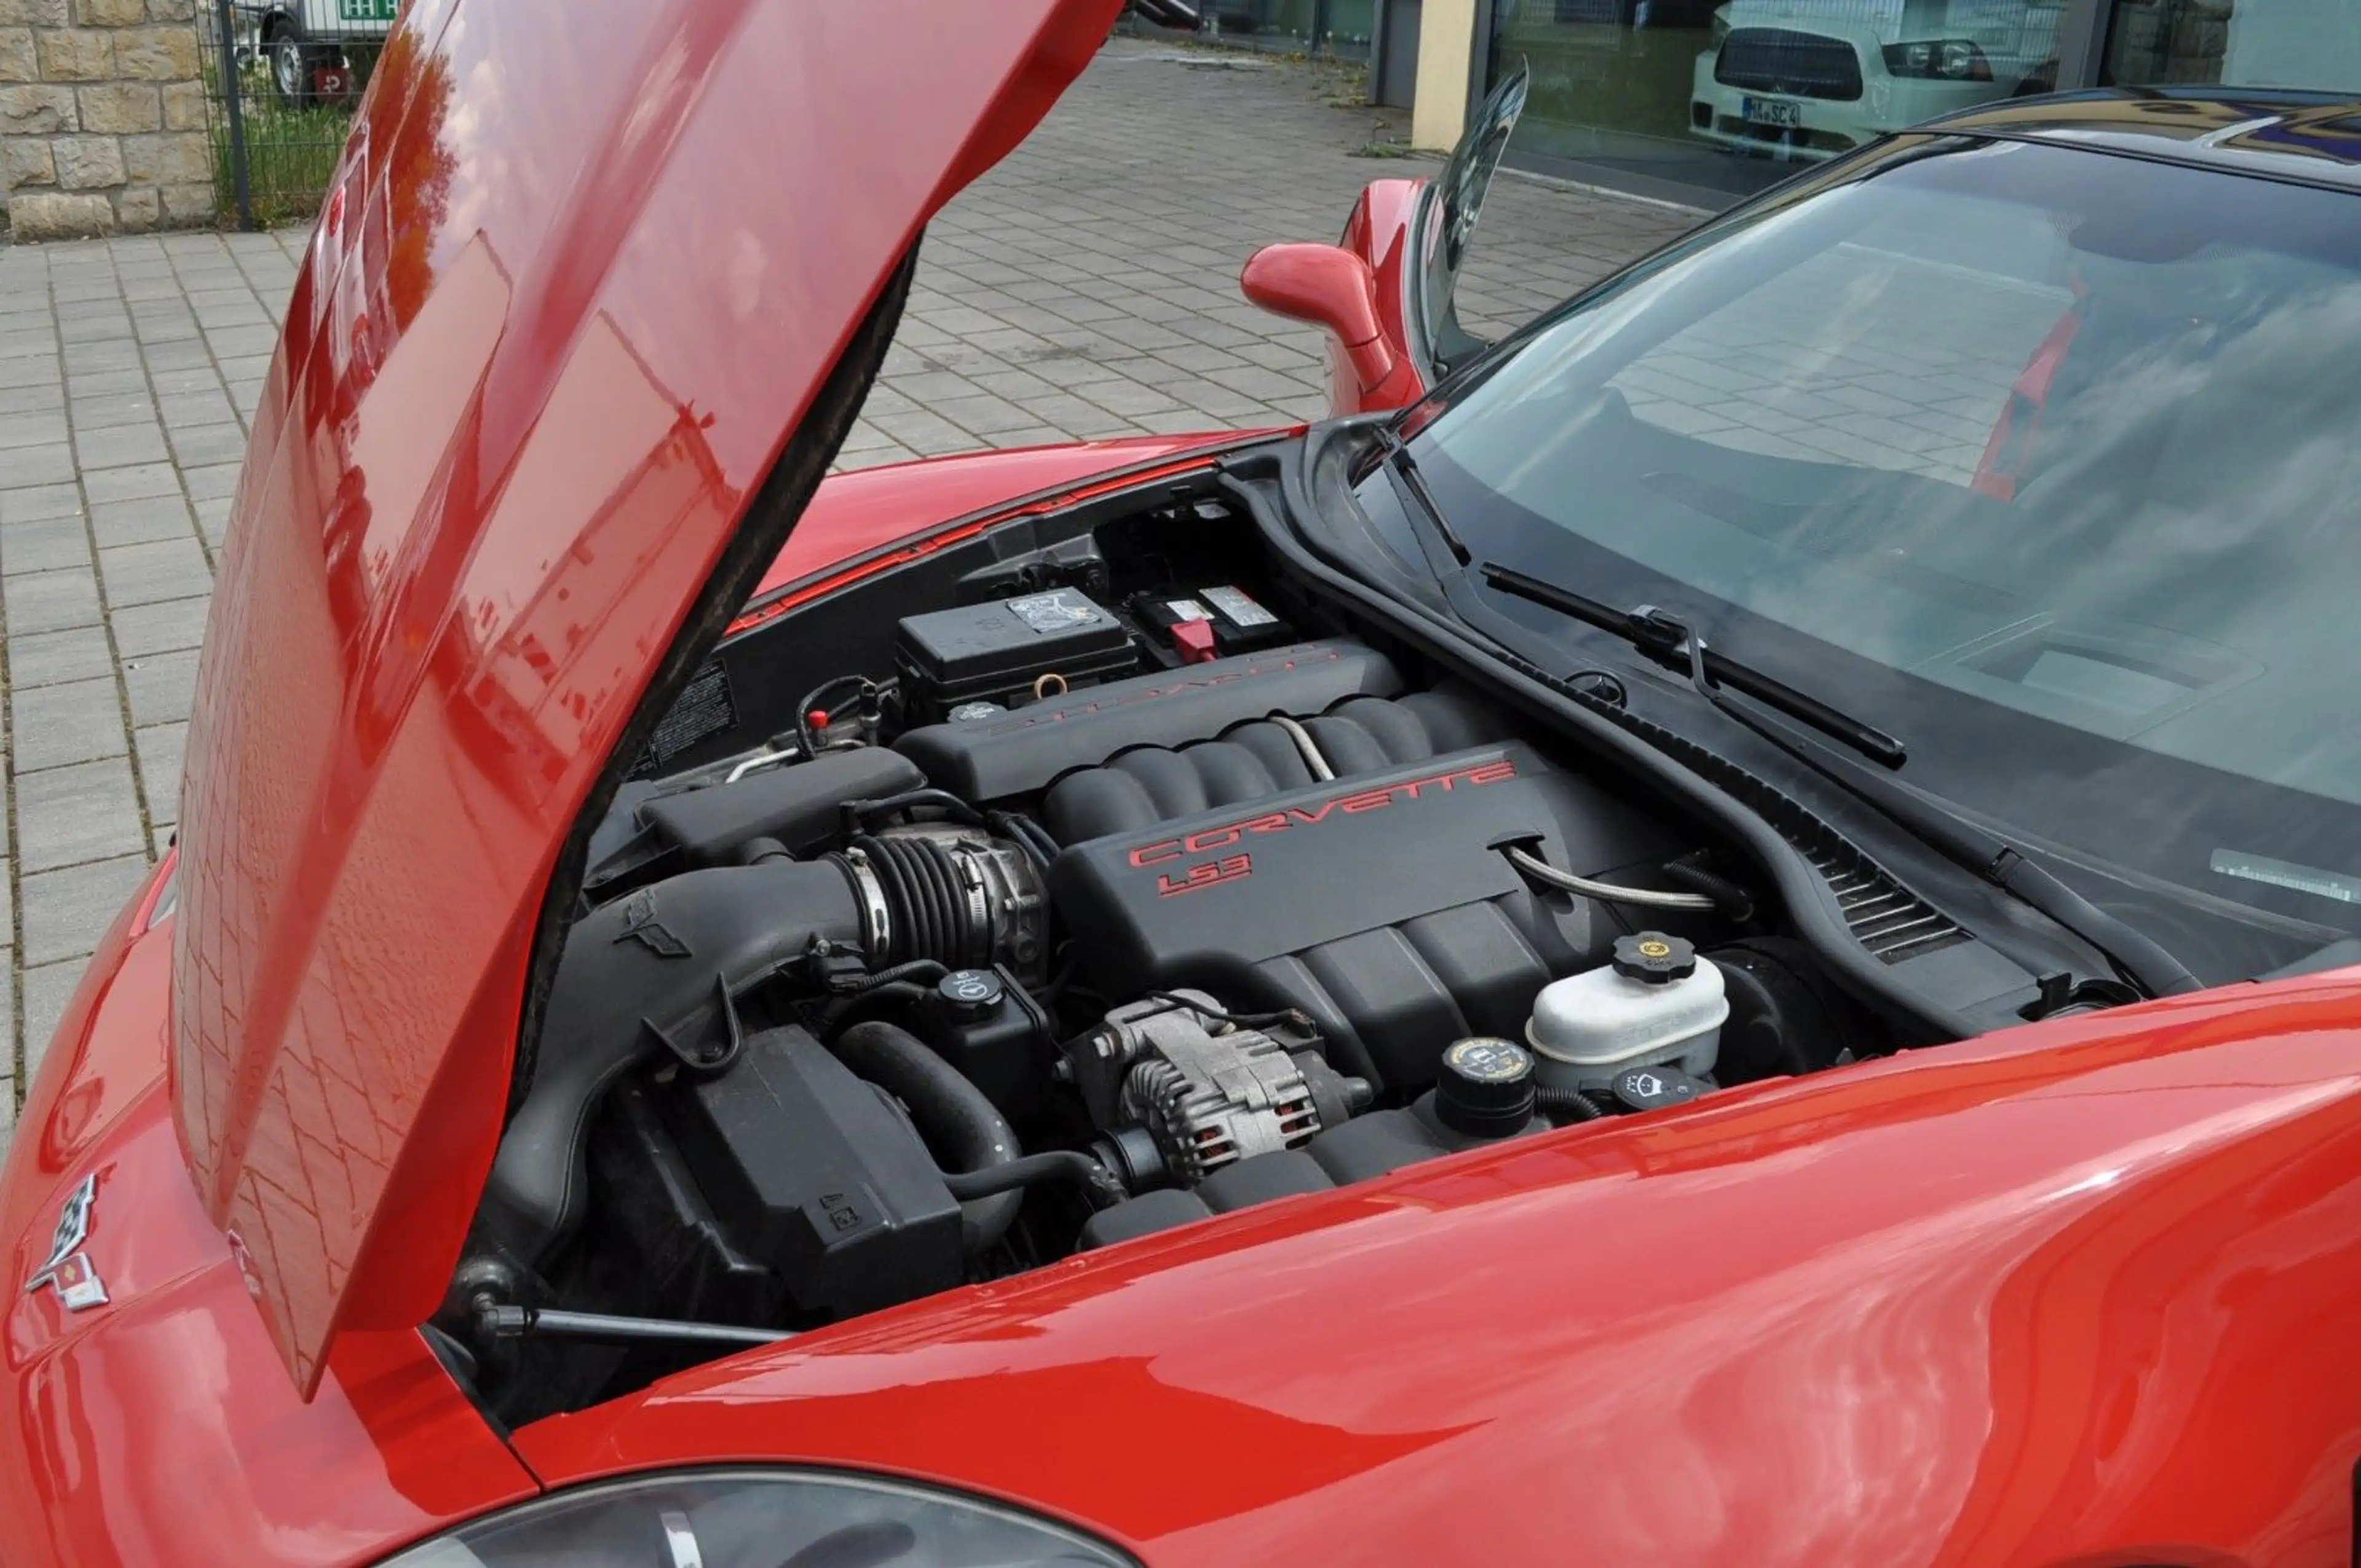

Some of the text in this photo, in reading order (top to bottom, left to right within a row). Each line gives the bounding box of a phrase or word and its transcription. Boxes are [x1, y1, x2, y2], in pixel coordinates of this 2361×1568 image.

[1772, 105, 1787, 123] SC
[1790, 107, 1796, 125] 4
[1129, 760, 1516, 867] CORVETTE
[1157, 853, 1252, 897] LS3
